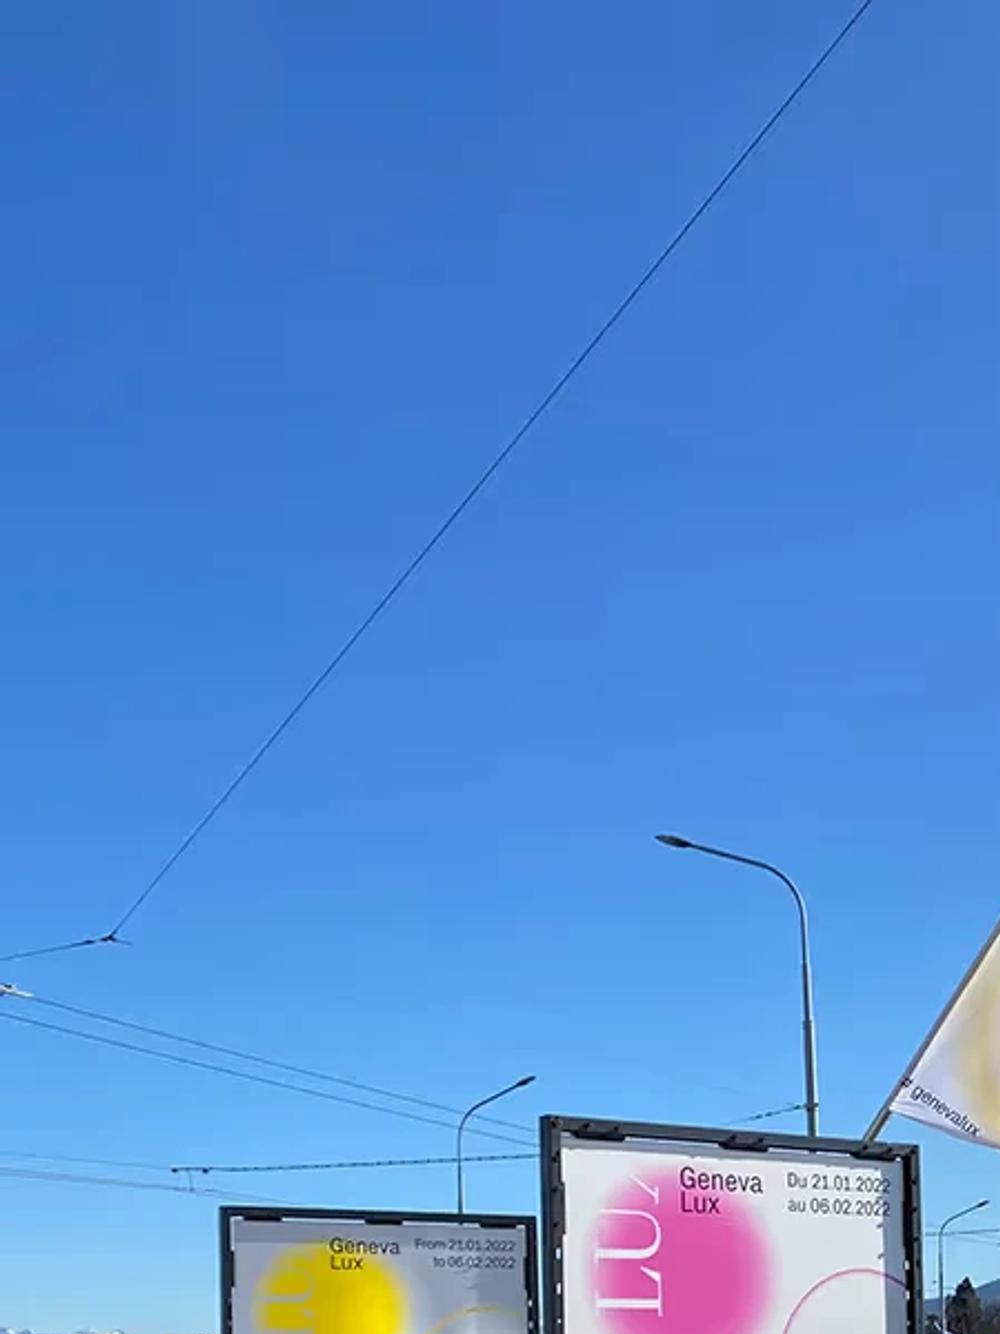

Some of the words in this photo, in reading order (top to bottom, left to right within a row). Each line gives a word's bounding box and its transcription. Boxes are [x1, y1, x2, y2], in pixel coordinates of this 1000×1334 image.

[679, 1166, 764, 1195] Geneva
[786, 1171, 808, 1189] Du
[811, 1173, 891, 1194] 21.01.2022
[680, 1191, 721, 1215] Lux
[786, 1199, 806, 1214] au
[809, 1197, 891, 1217] 06.02.2022
[329, 1236, 401, 1256] Geneva
[414, 1238, 447, 1251] From
[330, 1254, 364, 1271] Lux
[433, 1256, 446, 1269] to
